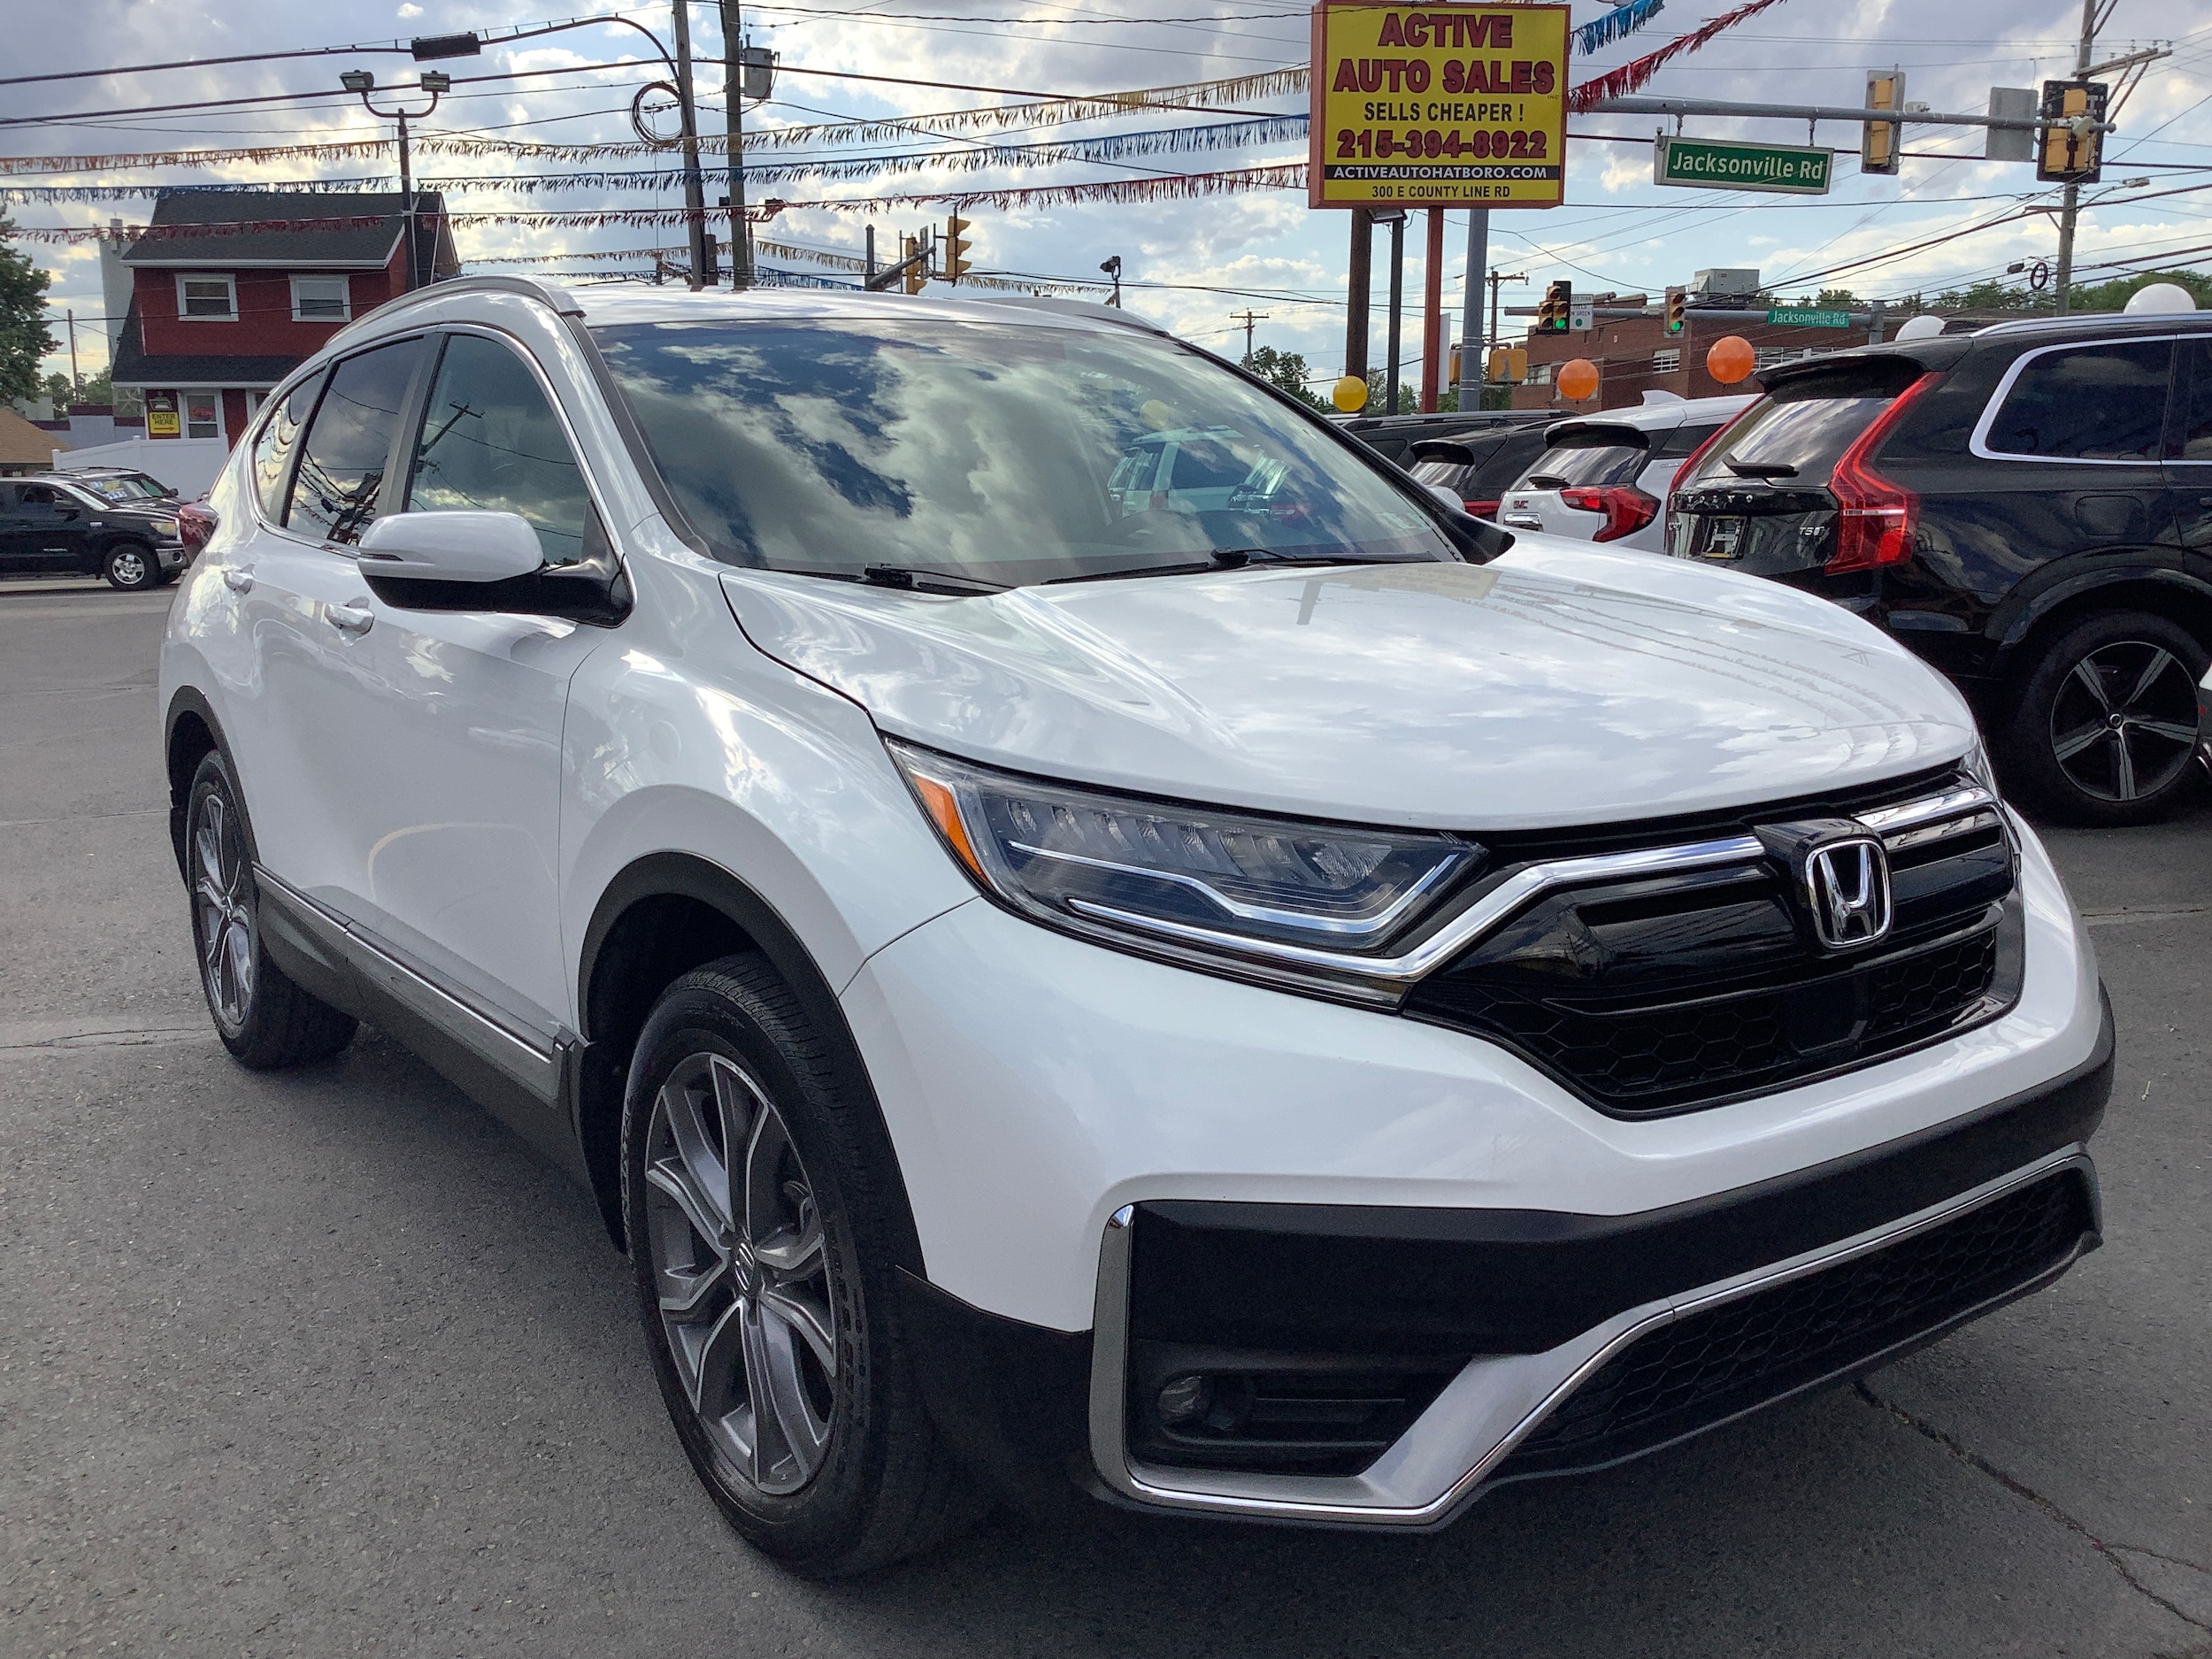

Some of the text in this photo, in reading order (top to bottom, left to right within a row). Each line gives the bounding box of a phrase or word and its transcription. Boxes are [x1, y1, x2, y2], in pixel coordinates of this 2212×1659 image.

[1378, 12, 1513, 49] ACTIVE
[1333, 58, 1555, 94] AUTO SALES
[1364, 102, 1420, 121] SELLS
[1427, 103, 1512, 122] CHEAPER
[1336, 129, 1547, 158] 215-394-8922
[1333, 165, 1547, 179] ACTIVEAUTOHATBORO.COM
[1672, 151, 1824, 180] Jacksonville Rd
[1371, 186, 1510, 197] 300 E COUNTY LINE RD
[1772, 310, 1846, 325] Jacksonville Rd
